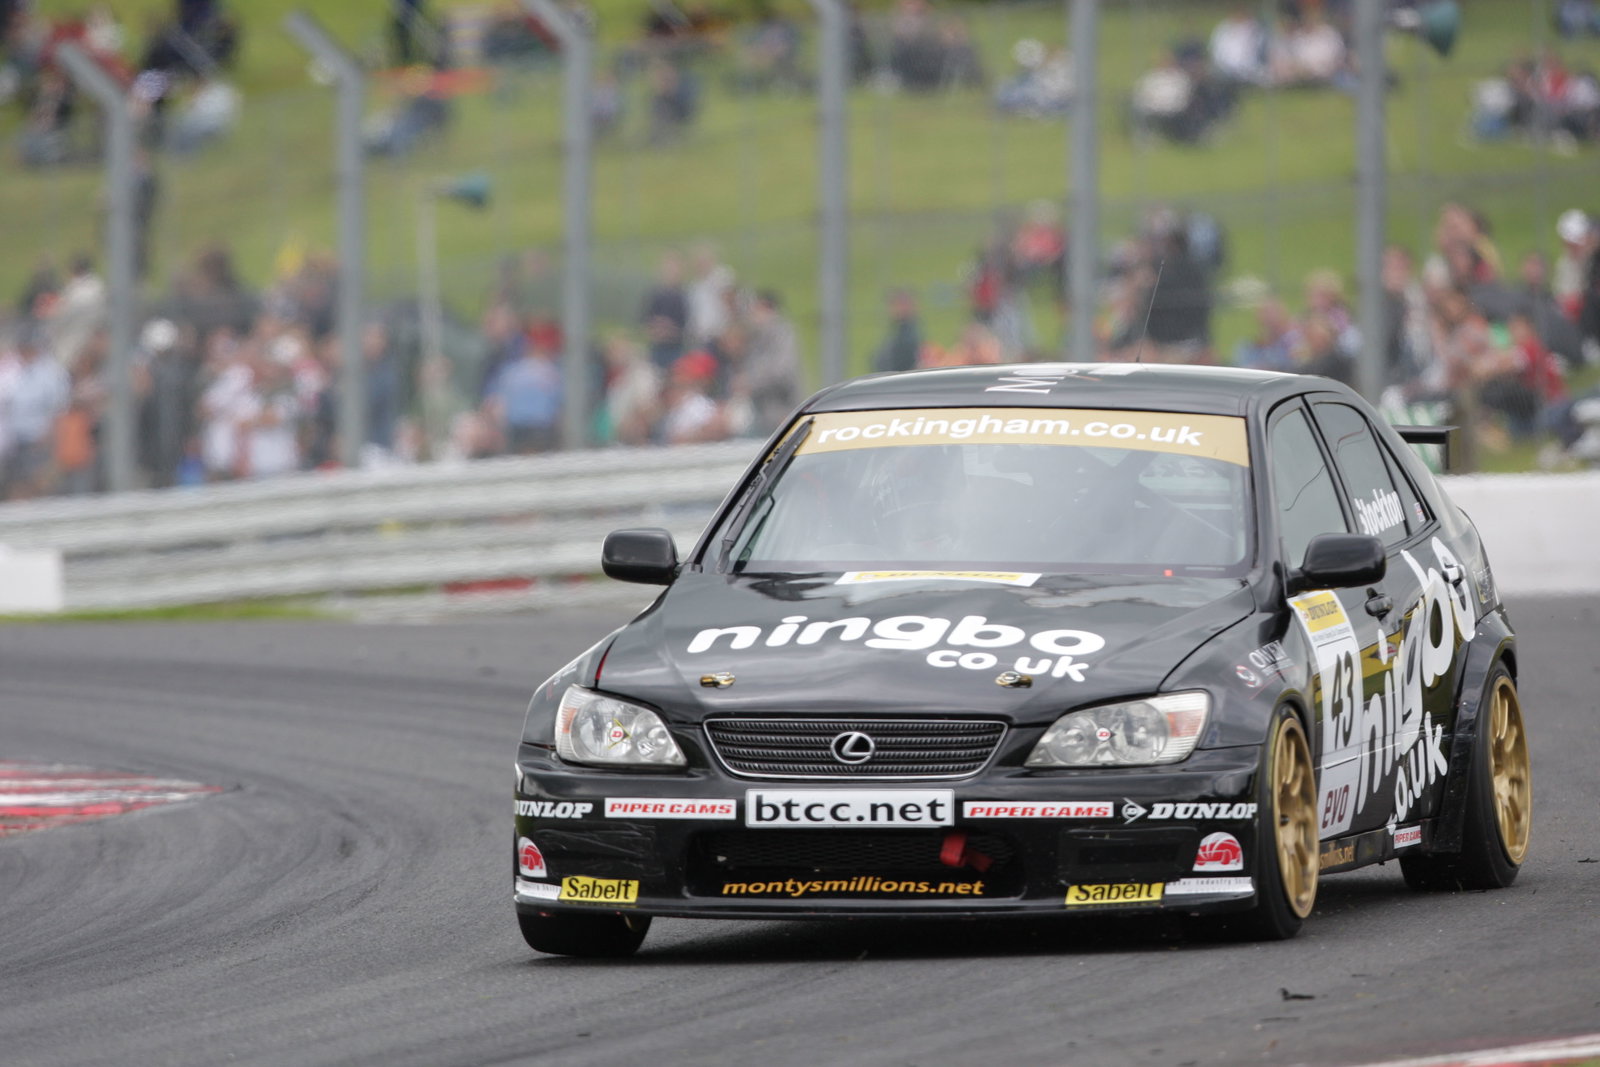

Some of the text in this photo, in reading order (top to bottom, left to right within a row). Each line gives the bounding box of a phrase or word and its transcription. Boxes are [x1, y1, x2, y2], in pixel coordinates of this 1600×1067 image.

[817, 414, 1204, 446] rockingham.co.uk
[687, 615, 1106, 656] ningbo
[1331, 650, 1354, 751] 43
[514, 799, 594, 819] DUNLOP
[609, 802, 732, 814] PIPER CAMS
[755, 794, 946, 822] btcc.net
[970, 806, 1109, 817] PIPER CAMS
[1147, 802, 1258, 819] DUNLOP
[1321, 784, 1350, 829] evo
[566, 877, 632, 900] Sabelt
[722, 876, 984, 897] montysmillions.net
[1074, 884, 1154, 902] Sabelt
